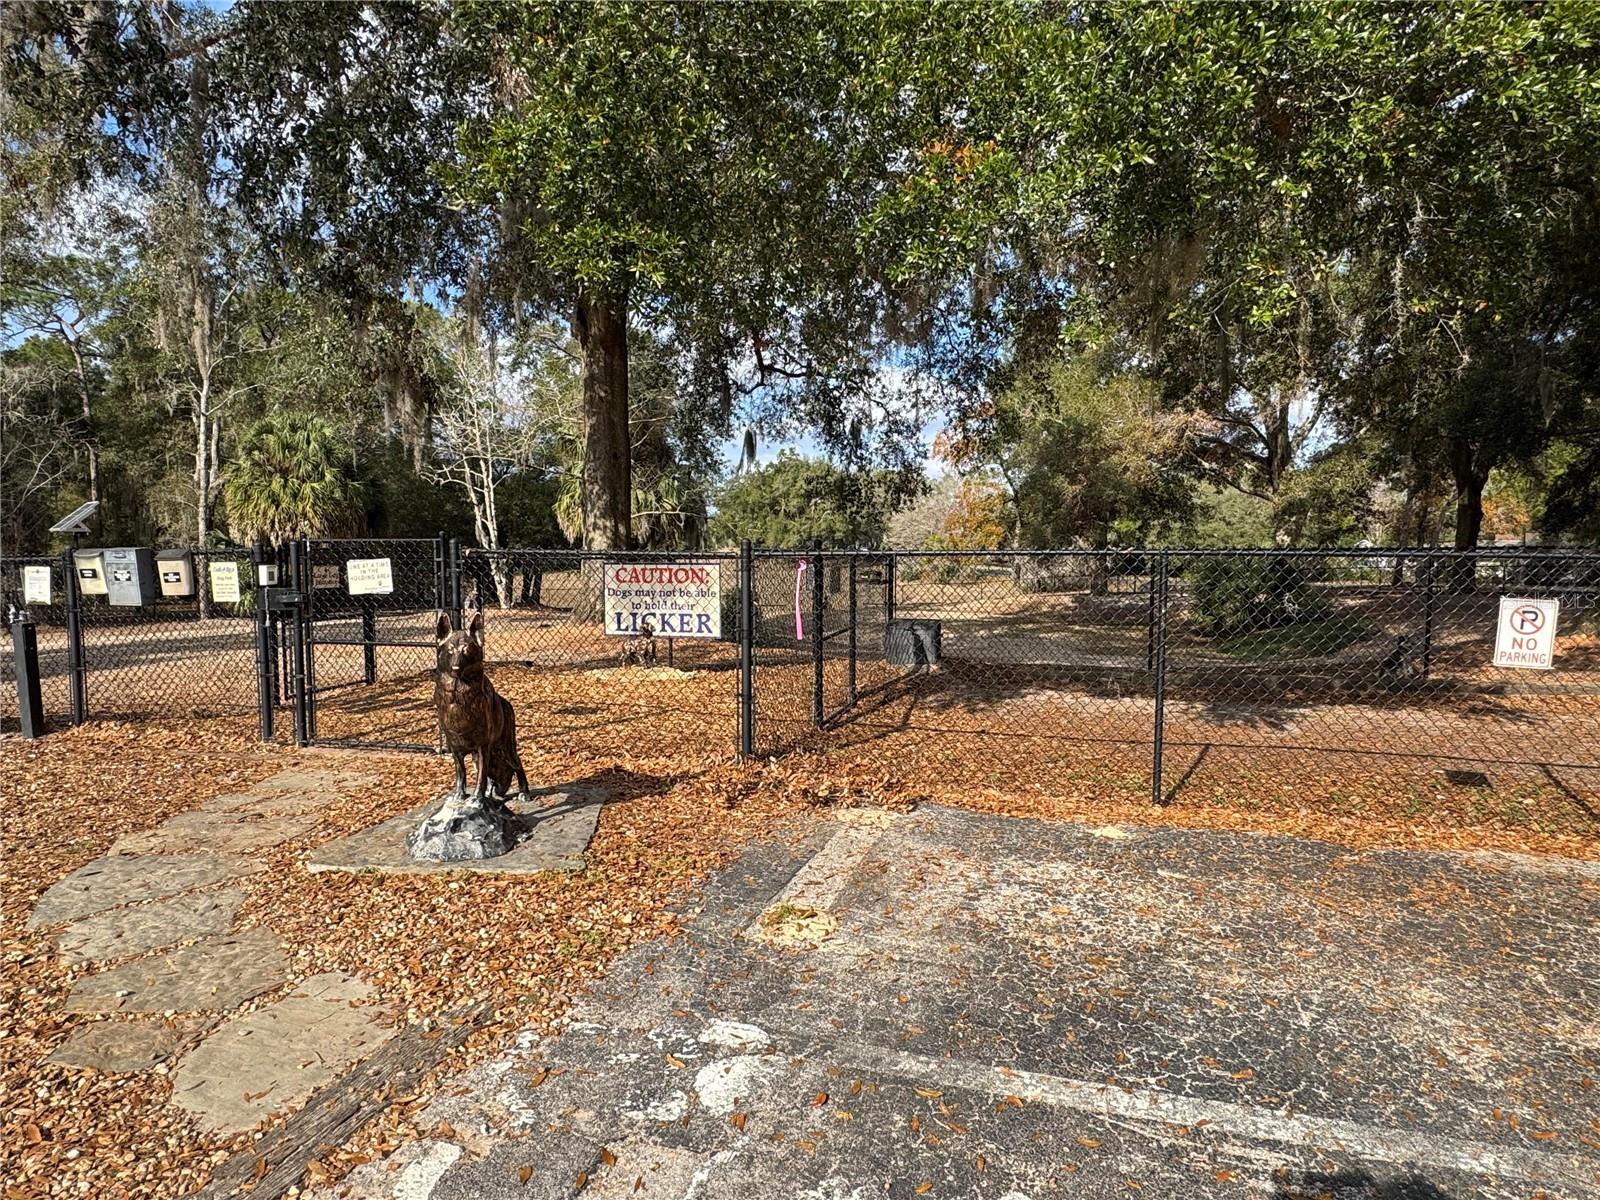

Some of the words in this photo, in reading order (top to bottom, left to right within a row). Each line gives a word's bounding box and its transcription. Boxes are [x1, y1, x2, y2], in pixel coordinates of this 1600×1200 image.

[350, 574, 376, 582] HOLDING
[615, 567, 710, 584] CAUTION:
[607, 587, 632, 599] Dogs
[635, 589, 656, 599] may
[659, 588, 676, 597] not
[679, 588, 692, 597] be
[694, 588, 717, 597] able
[632, 601, 642, 610] to
[645, 601, 667, 610] hold
[671, 601, 696, 610] their
[615, 611, 712, 634] LICKER
[1512, 637, 1538, 651] NO
[1500, 651, 1547, 664] PARKING
